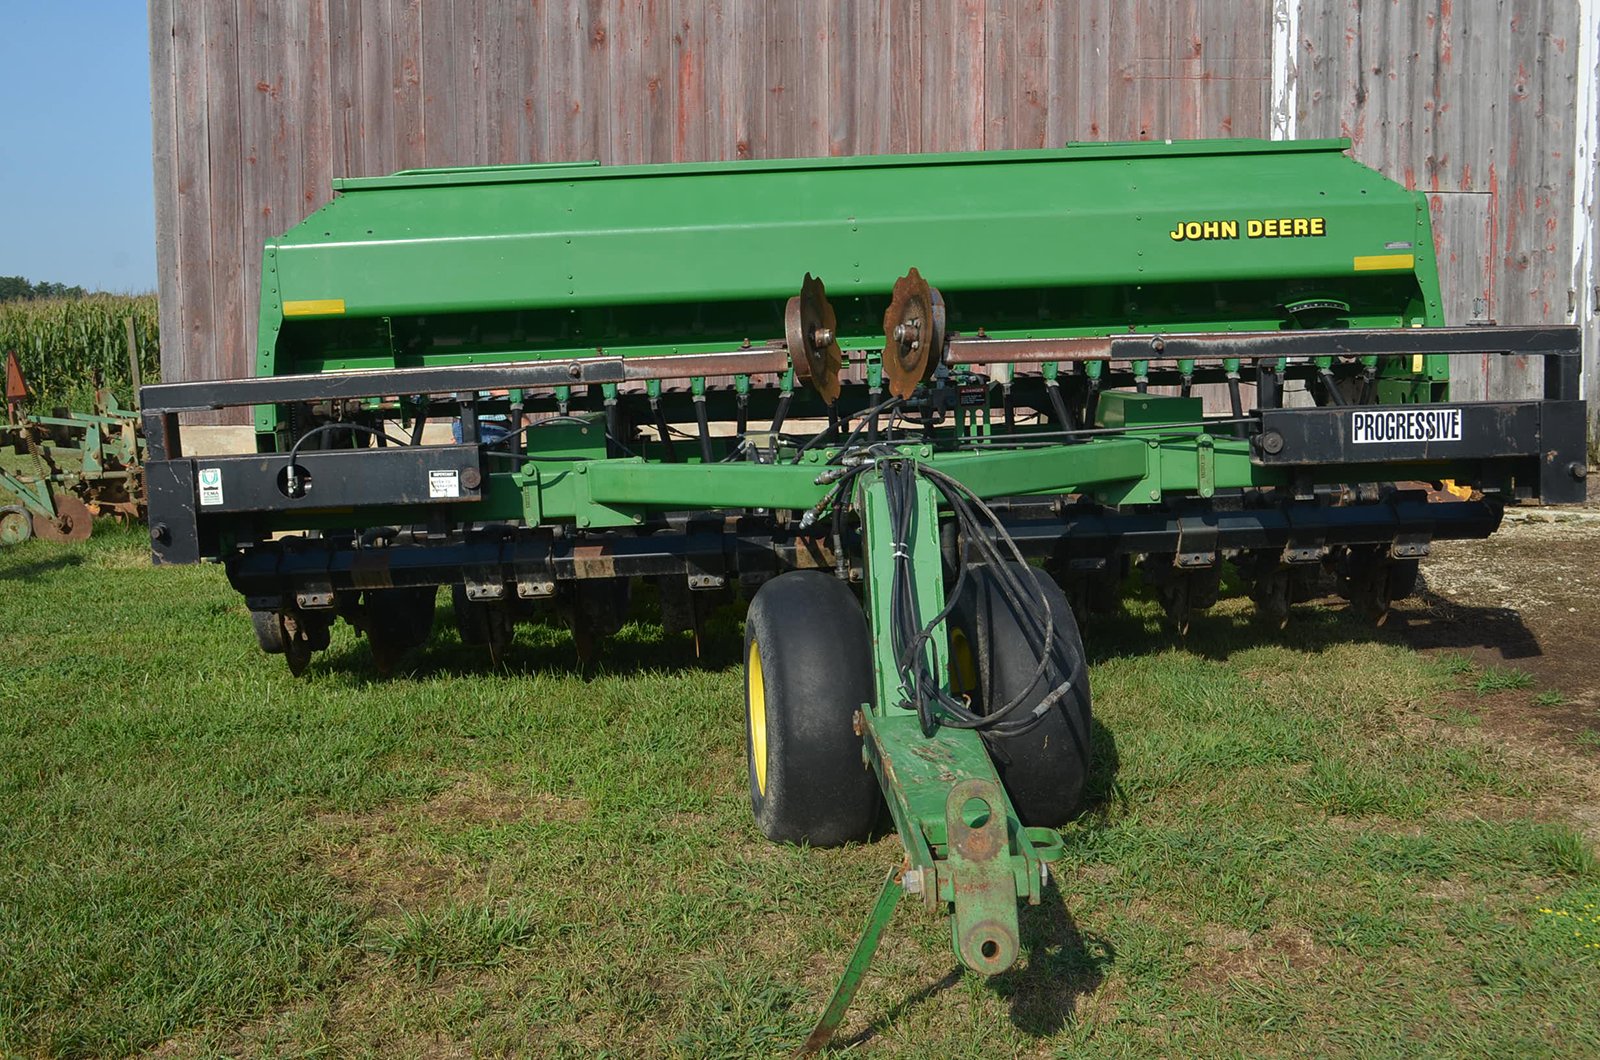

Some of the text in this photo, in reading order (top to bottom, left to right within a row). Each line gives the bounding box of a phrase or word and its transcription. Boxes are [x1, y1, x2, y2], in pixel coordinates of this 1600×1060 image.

[1170, 217, 1325, 241] JOHN DEERE
[1354, 412, 1459, 440] PROGRESSIVE
